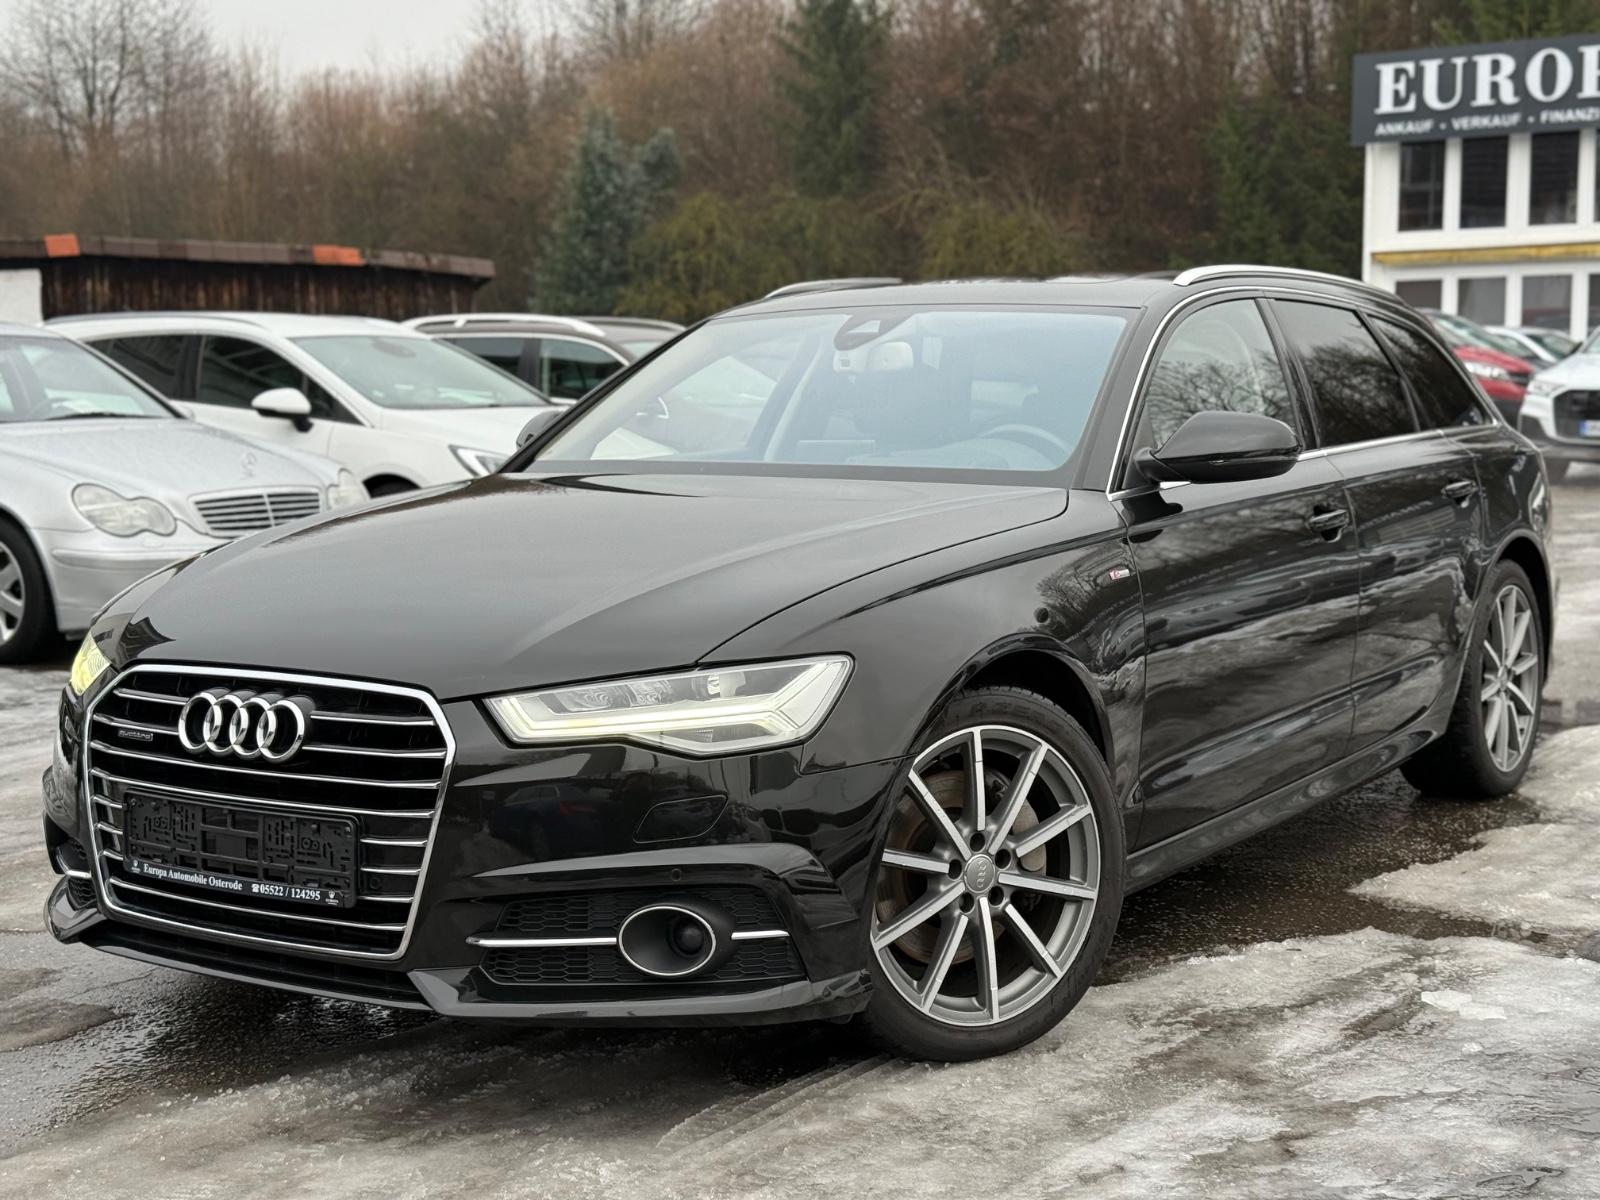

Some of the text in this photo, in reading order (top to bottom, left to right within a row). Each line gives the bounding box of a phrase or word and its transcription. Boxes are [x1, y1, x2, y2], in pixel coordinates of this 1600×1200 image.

[1374, 118, 1435, 136] ANKAUF
[1451, 112, 1522, 132] VERKAUF
[143, 863, 168, 879] Europa
[168, 868, 207, 885] Automobile
[208, 876, 243, 892] Osterode
[259, 883, 284, 897] 05522
[290, 887, 321, 901] 124295
